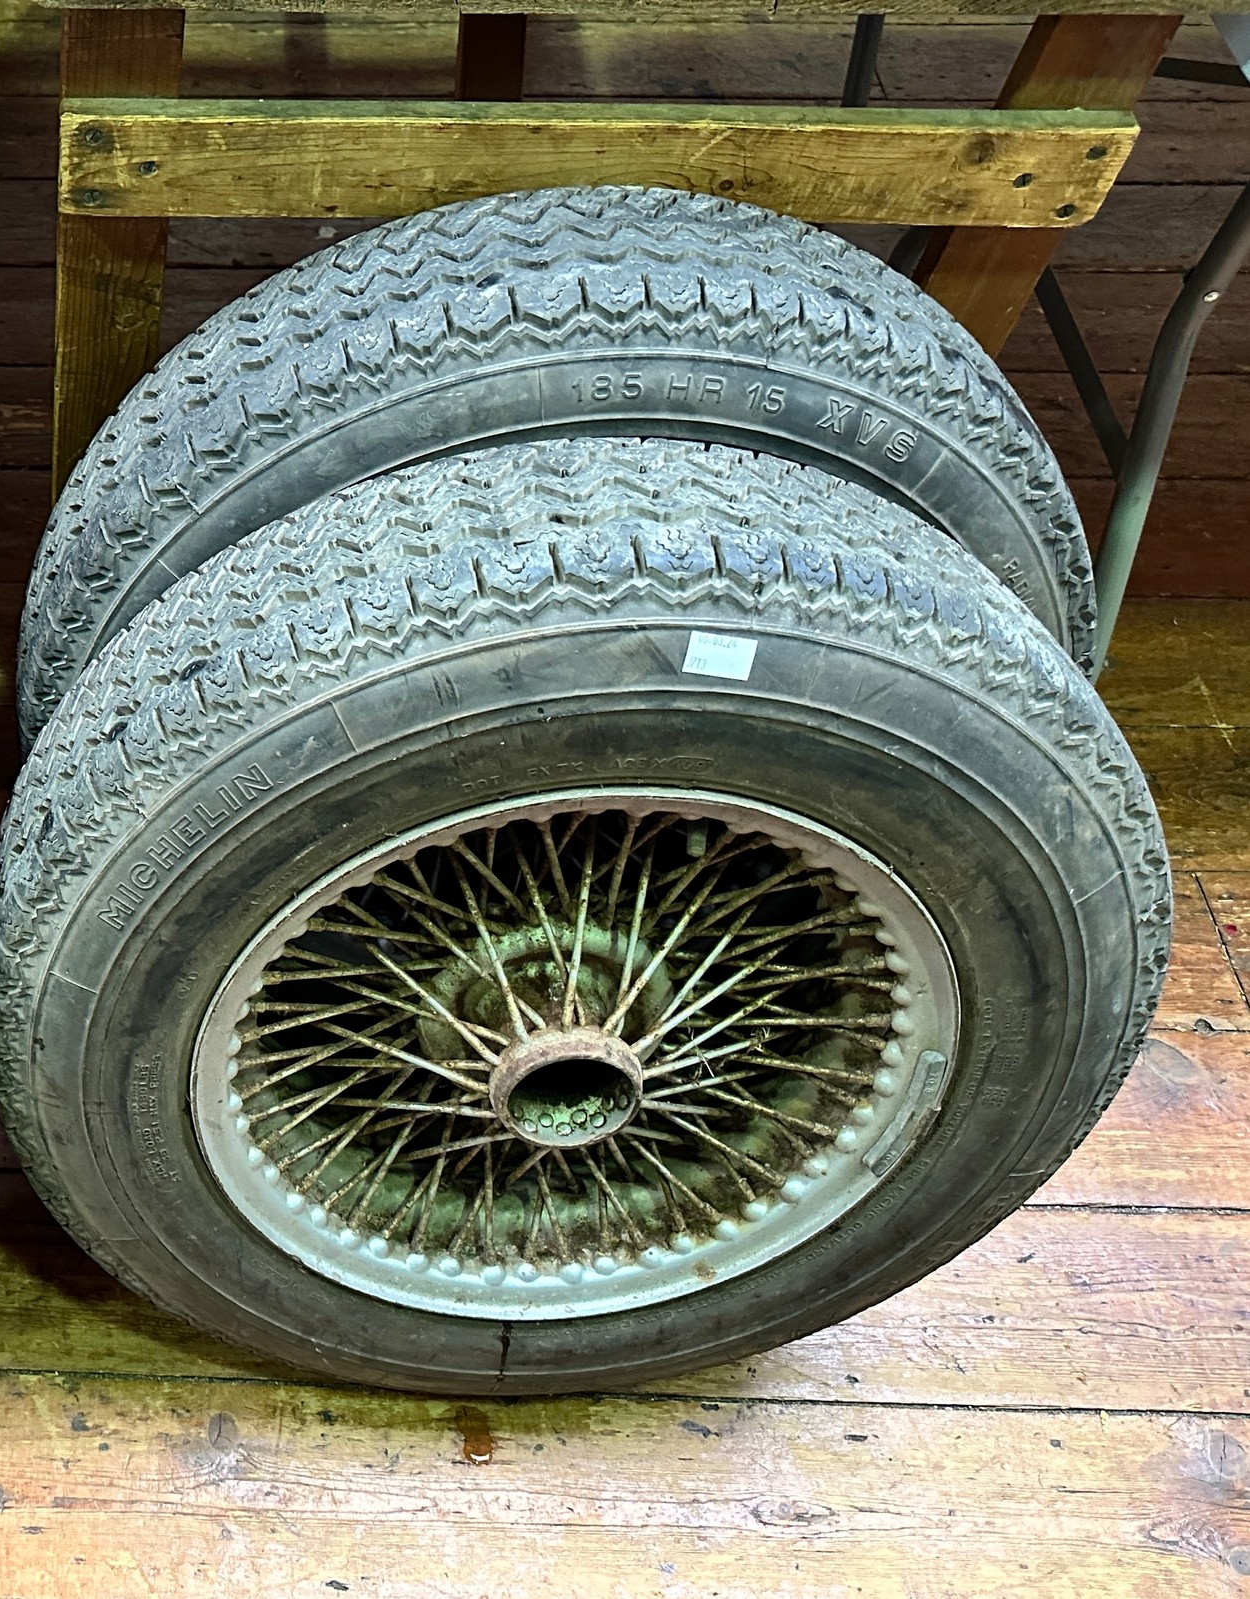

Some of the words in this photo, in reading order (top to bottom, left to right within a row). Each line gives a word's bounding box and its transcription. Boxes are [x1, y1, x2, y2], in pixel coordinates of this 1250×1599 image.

[571, 371, 643, 403] 185
[664, 374, 725, 404] HR
[747, 380, 786, 415] 15
[816, 396, 917, 464] XVS
[97, 762, 274, 932] MICHELIN
